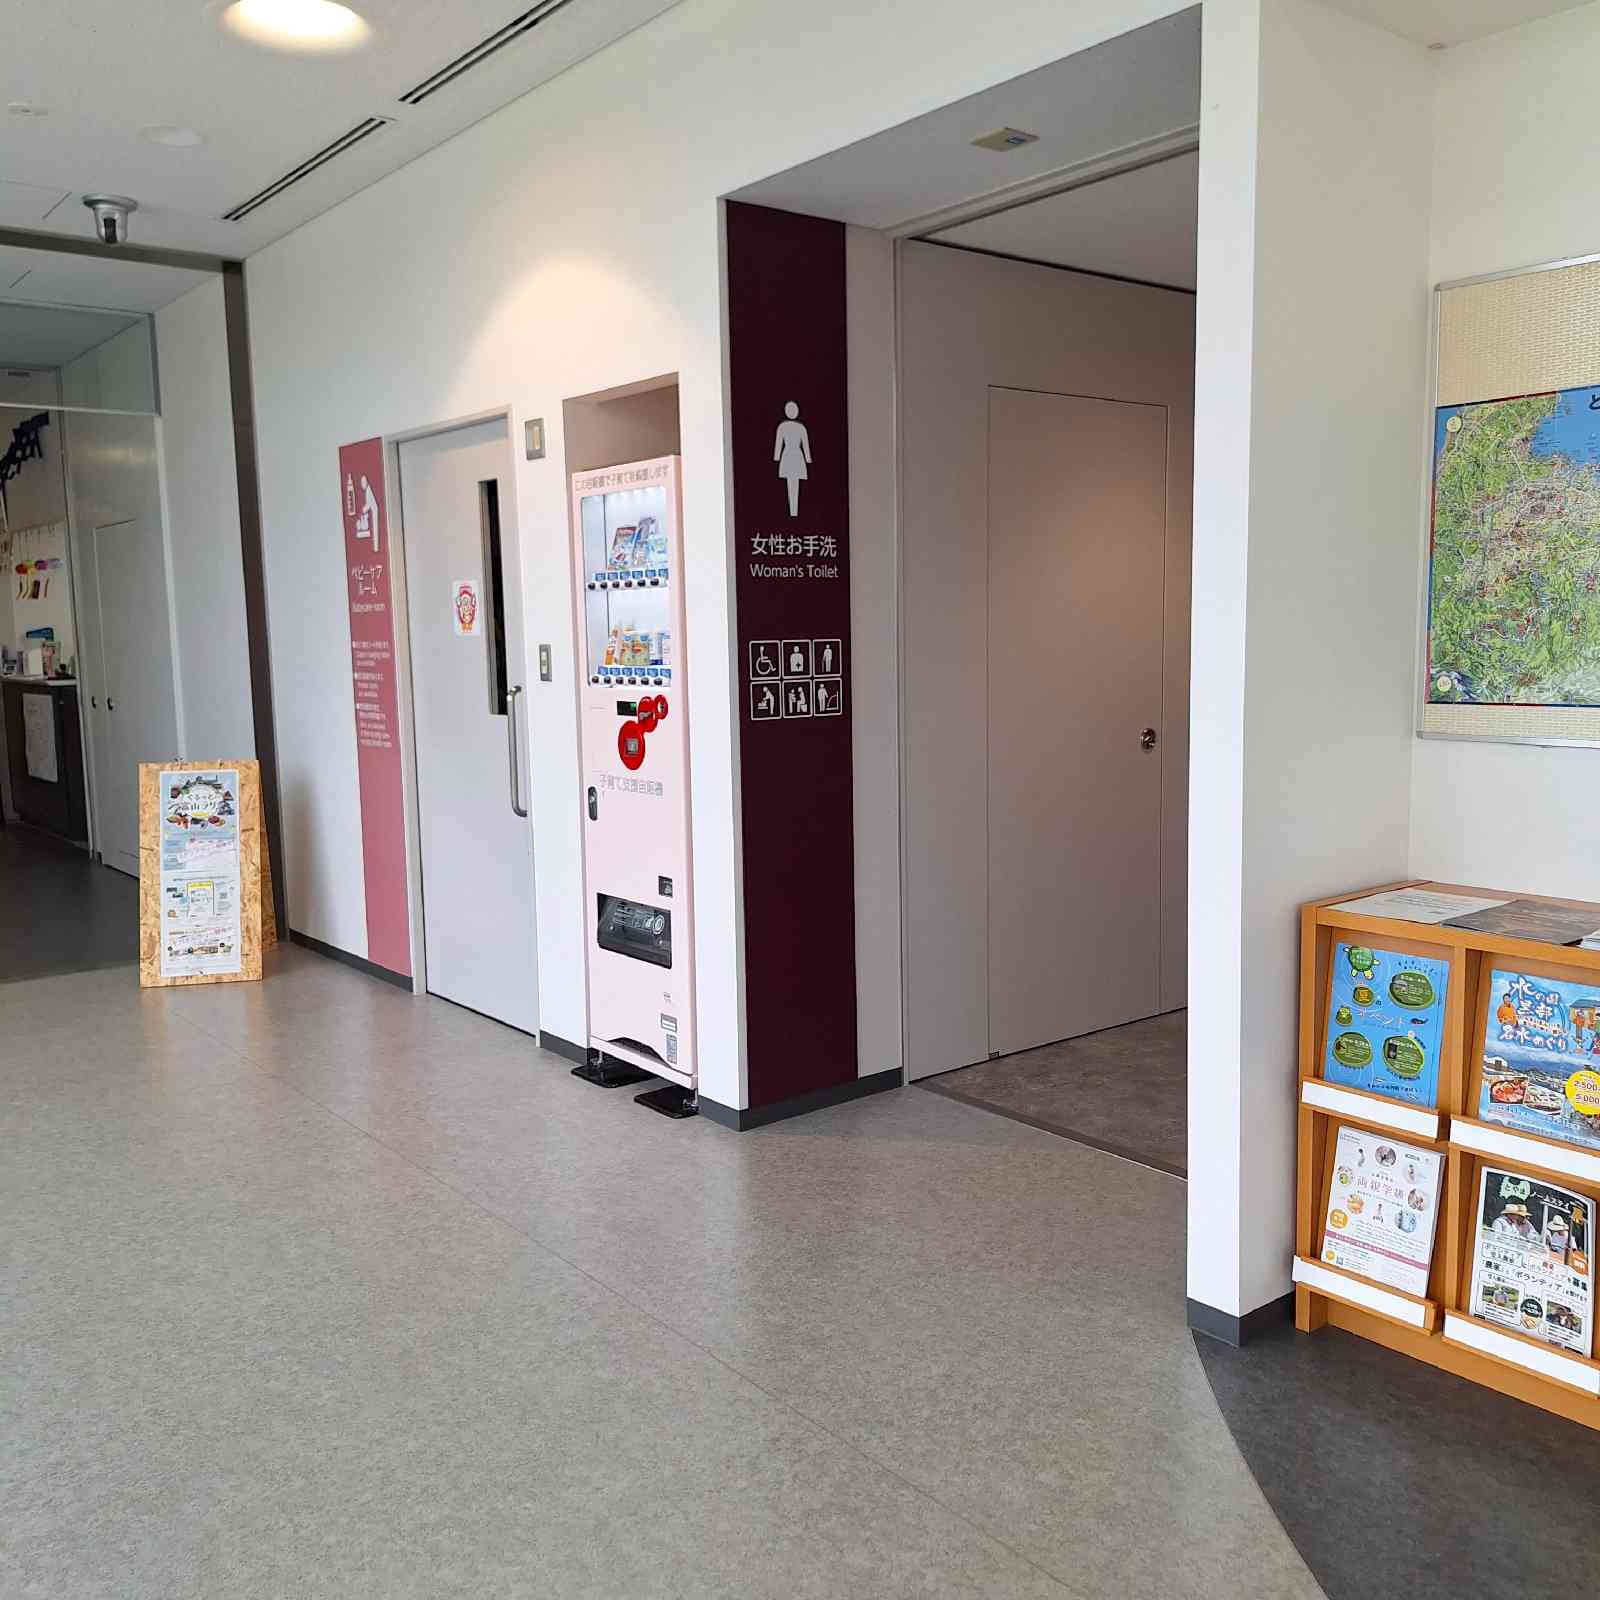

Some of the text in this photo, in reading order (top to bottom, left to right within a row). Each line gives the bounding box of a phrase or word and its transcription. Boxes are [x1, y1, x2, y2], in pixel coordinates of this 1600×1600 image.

[751, 532, 837, 558] 女性お手洗
[749, 563, 839, 578] Woman's Toilet
[1499, 1025, 1567, 1051] 名水めぐり
